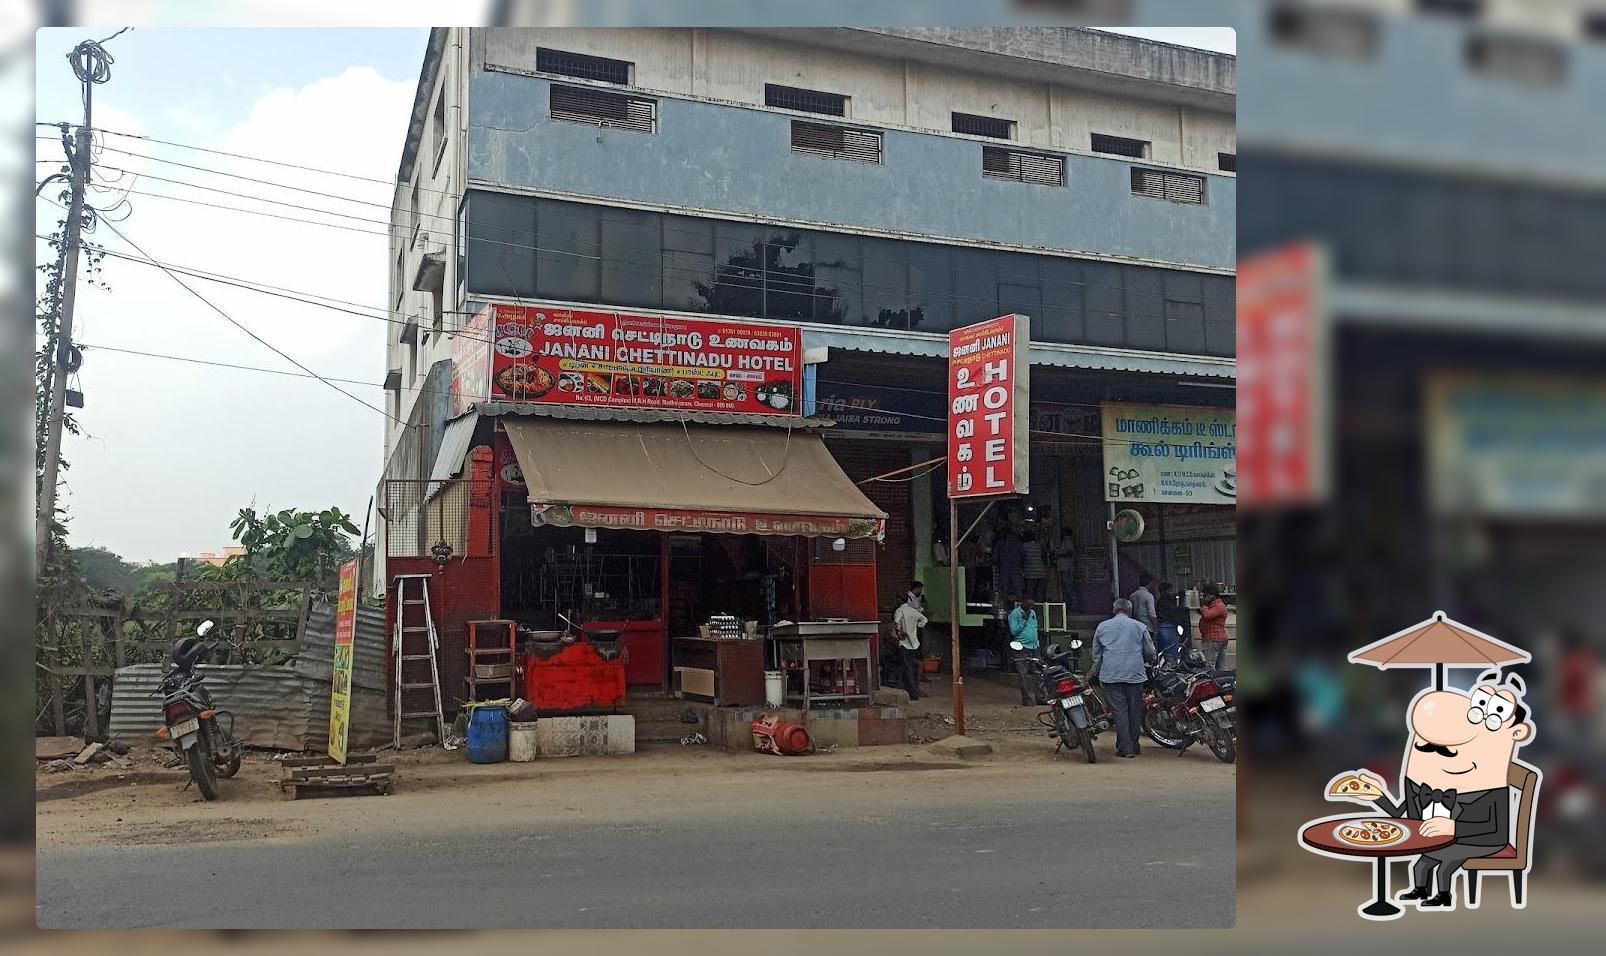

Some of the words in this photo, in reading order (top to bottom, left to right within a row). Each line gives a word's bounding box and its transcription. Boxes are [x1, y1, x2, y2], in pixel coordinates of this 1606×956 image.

[544, 323, 605, 339] ஜனனி
[612, 328, 702, 349] செட்டிநாடு
[709, 335, 793, 351] உணவகம்
[982, 332, 1010, 350] JANANI
[541, 342, 609, 360] JANANI
[617, 347, 732, 368] CHETTINADU
[738, 355, 793, 371] HOTEL
[953, 339, 980, 358] ஜனனி
[863, 416, 901, 425] STRONG
[952, 367, 979, 491] உணவகம்
[984, 359, 1008, 488] HOTEL
[1116, 417, 1192, 435] மாணிக்கம்
[1131, 441, 1169, 457] கூல்
[580, 511, 644, 525] ஜனனி
